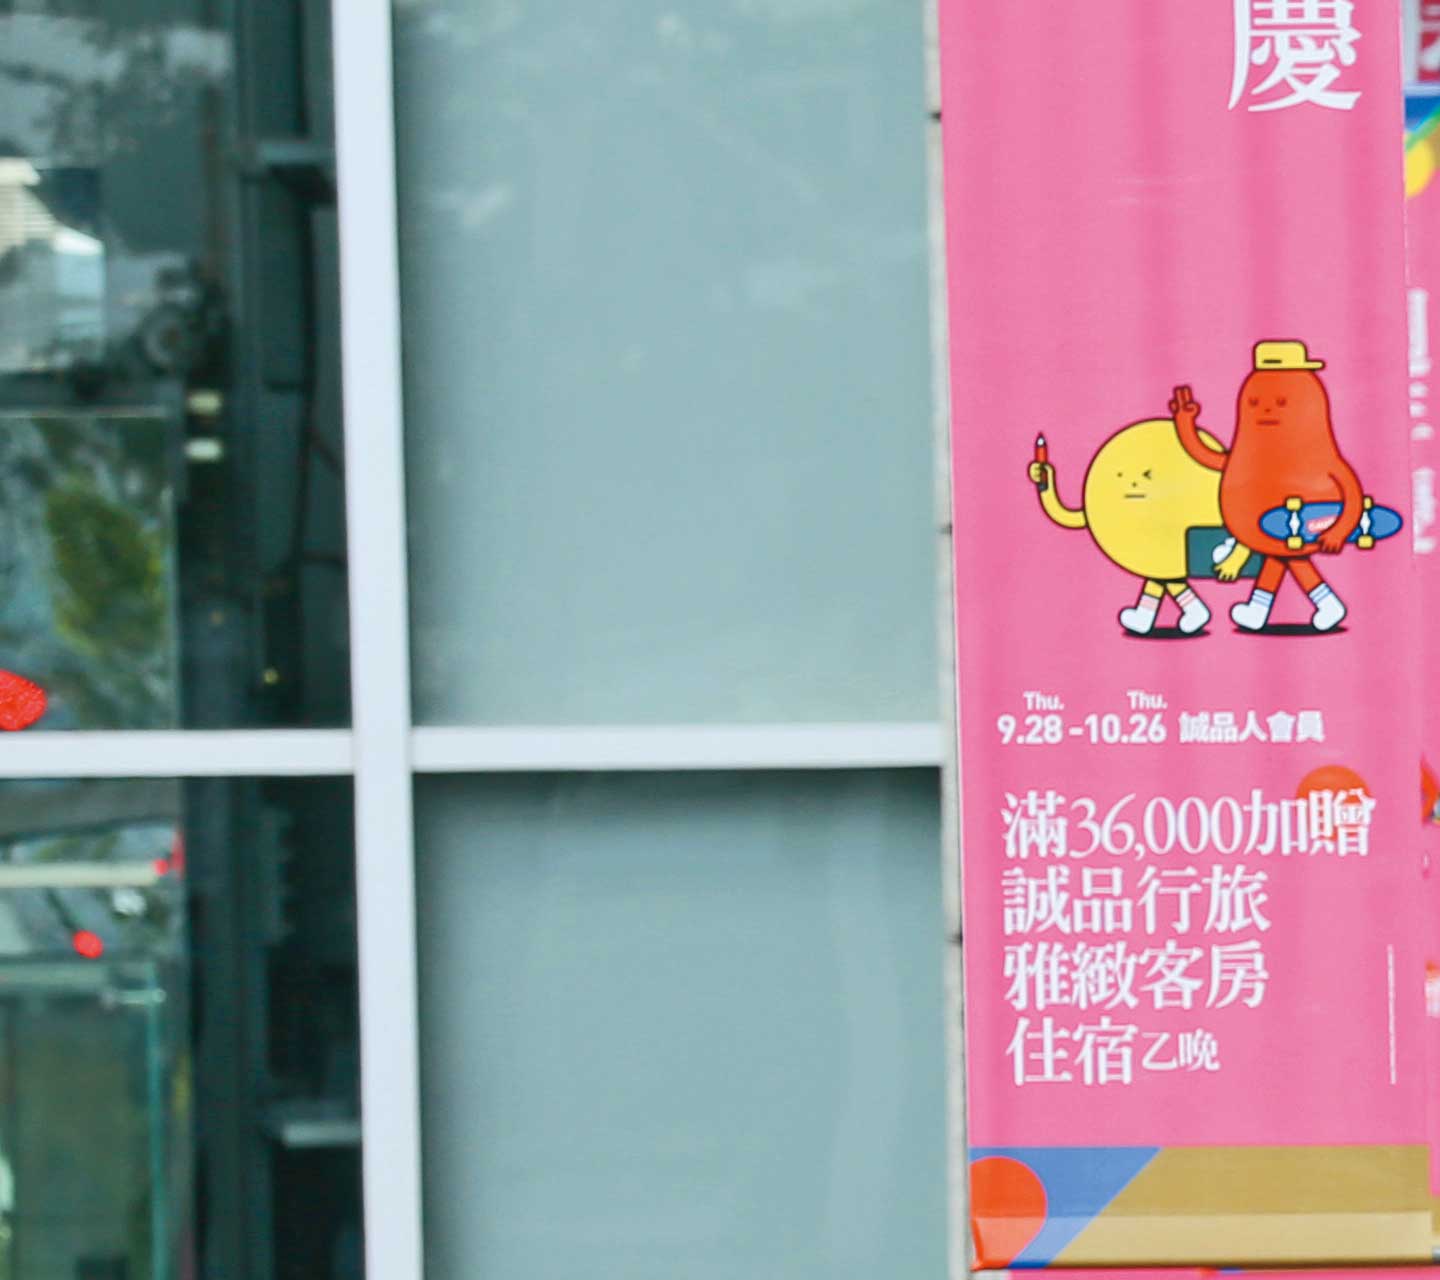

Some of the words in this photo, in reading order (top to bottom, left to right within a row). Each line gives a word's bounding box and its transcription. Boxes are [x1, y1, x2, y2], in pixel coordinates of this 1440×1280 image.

[1228, 0, 1361, 112] 慶
[1024, 692, 1065, 710] Thu.
[1127, 690, 1168, 709] Thu.
[1179, 711, 1325, 743] 誠品人會員
[1002, 788, 1377, 861] 滿36,000加贈
[1002, 864, 1271, 936] 誠品行旅
[1004, 939, 1270, 1011] 雅緻客房
